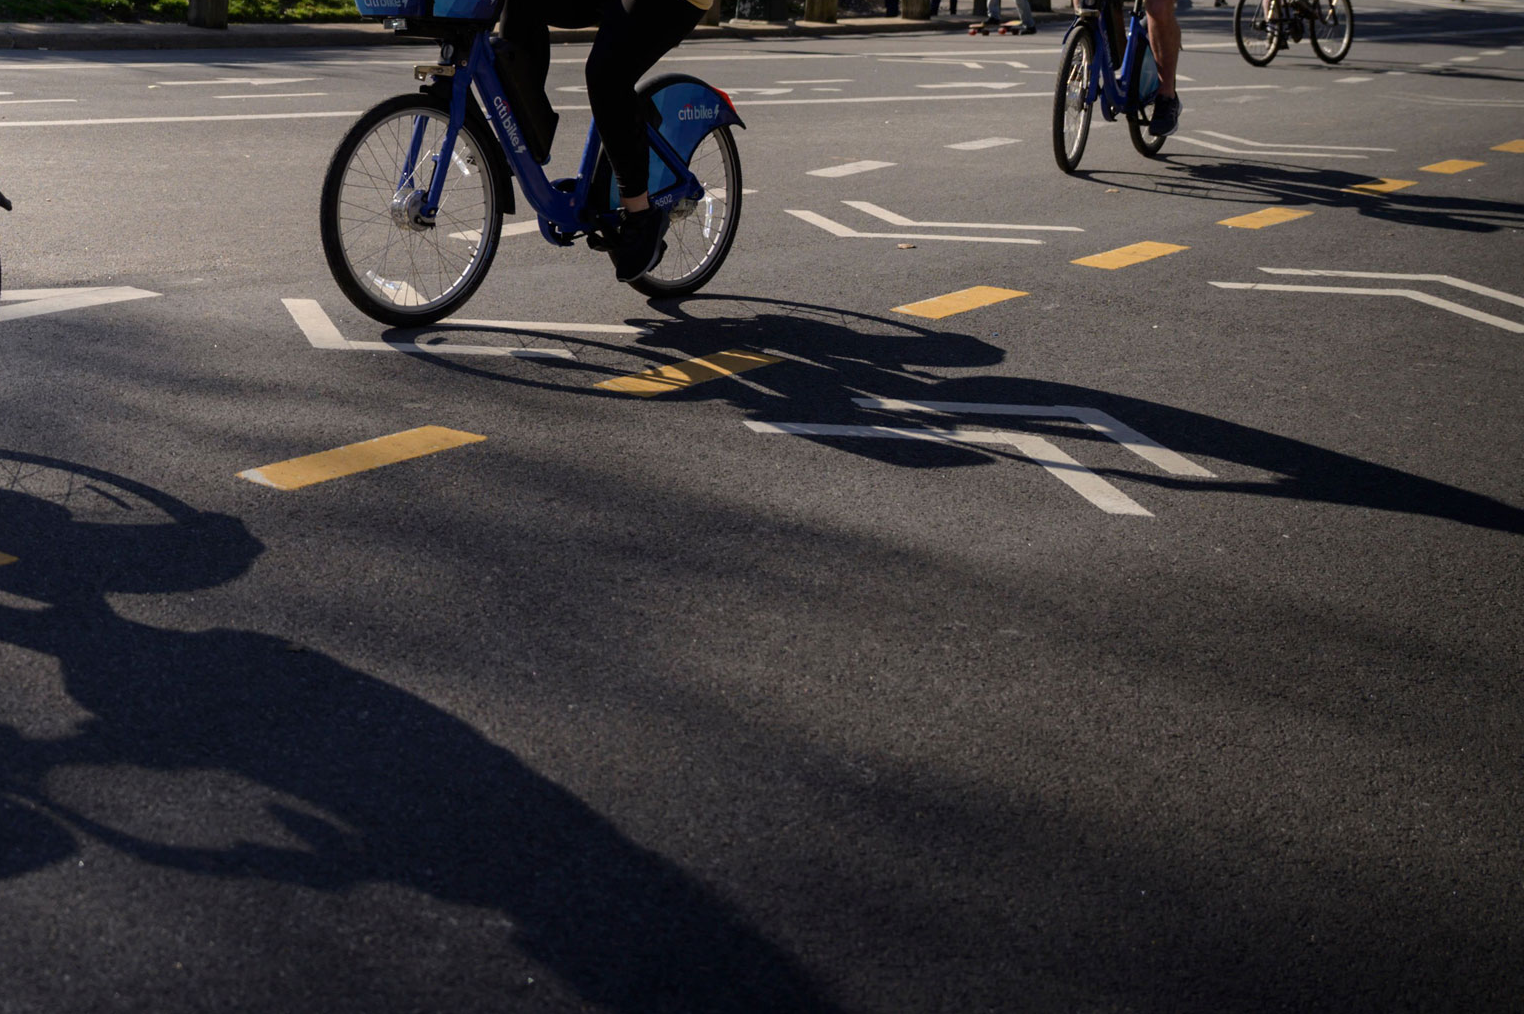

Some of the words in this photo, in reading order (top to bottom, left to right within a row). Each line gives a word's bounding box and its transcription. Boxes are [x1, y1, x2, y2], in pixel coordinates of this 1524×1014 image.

[493, 95, 510, 119] citi
[502, 117, 520, 147] bike
[678, 104, 693, 121] citi
[694, 104, 713, 119] bike
